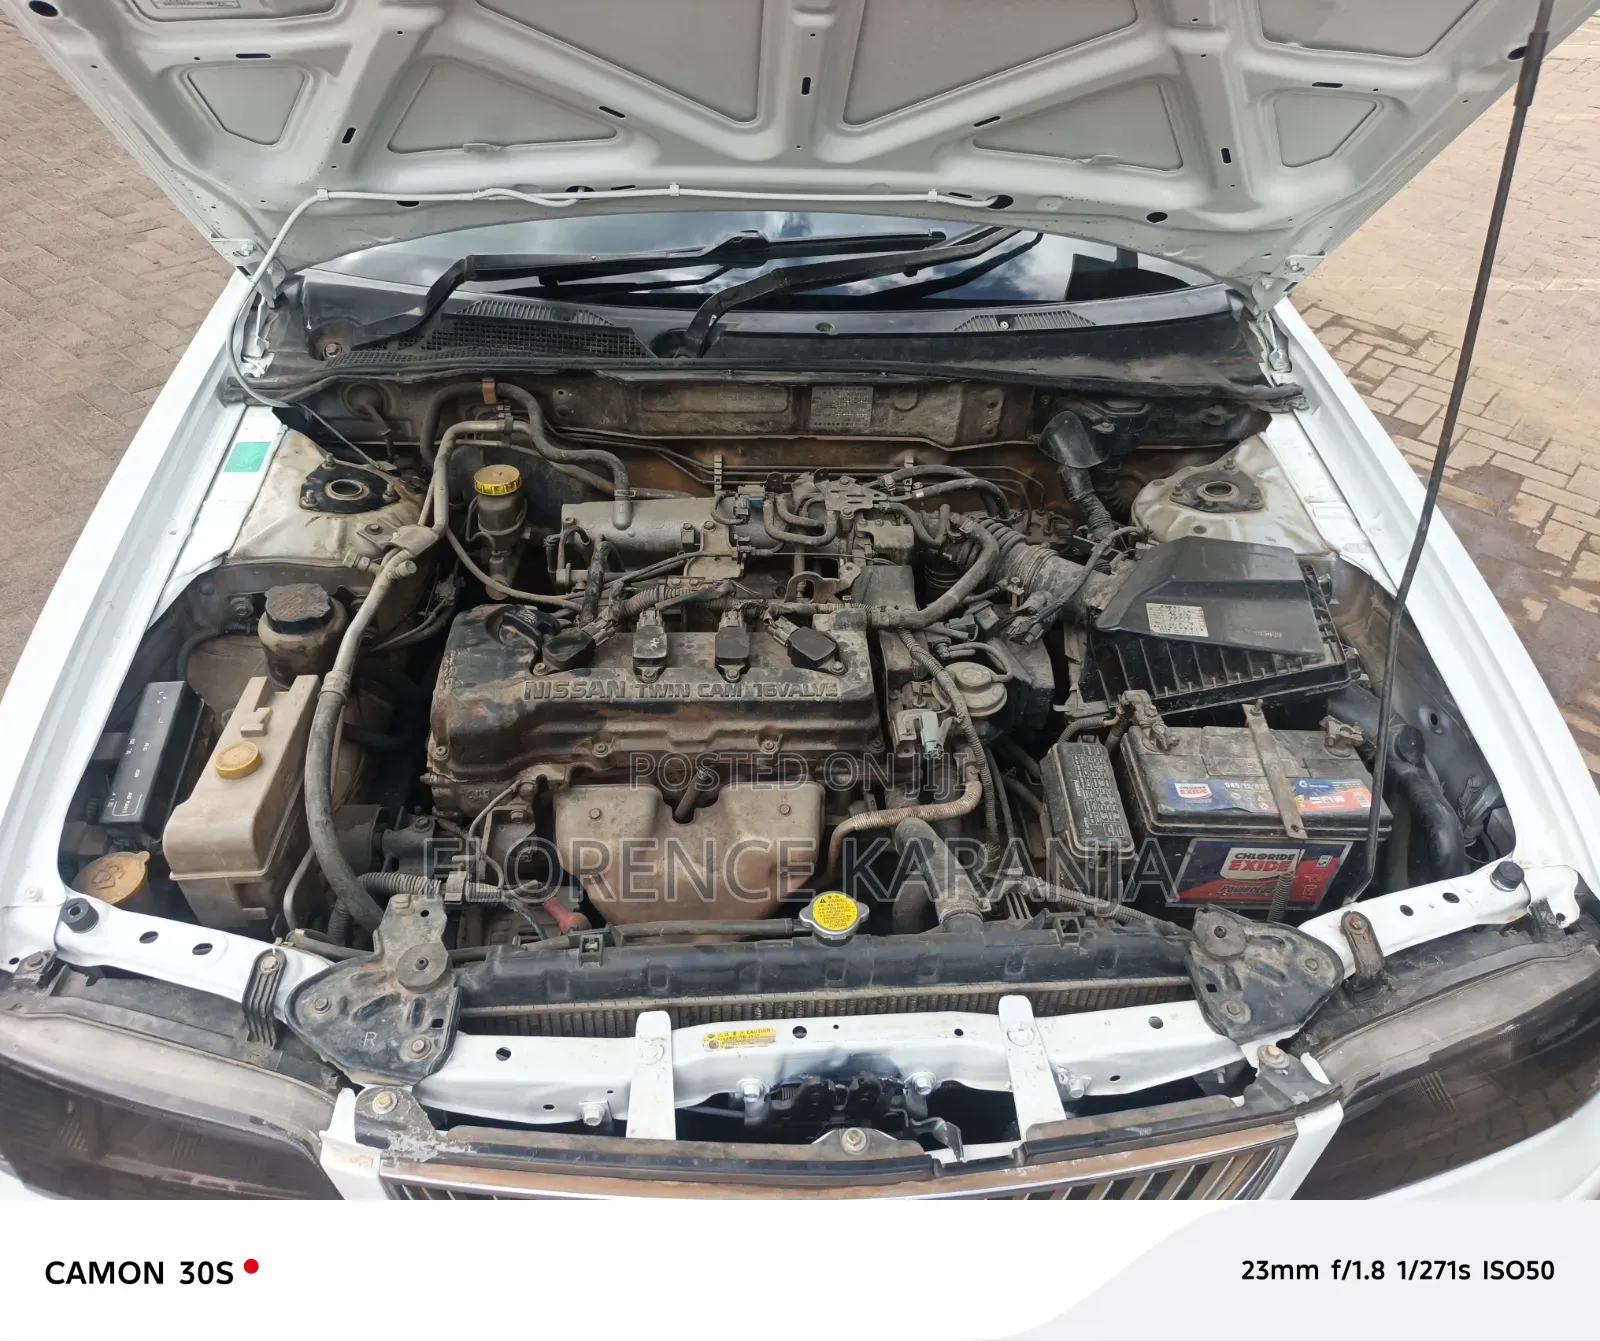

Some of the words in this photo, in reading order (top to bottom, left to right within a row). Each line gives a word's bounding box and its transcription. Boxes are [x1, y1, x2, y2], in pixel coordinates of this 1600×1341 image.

[524, 680, 627, 700] NISSAN
[635, 683, 691, 698] TWIN
[697, 683, 743, 698] CAM
[752, 682, 839, 698] 16VALVE
[1180, 788, 1208, 796] EXIDE
[1234, 852, 1296, 860] CHLORIDE
[1227, 860, 1293, 872] EXIDE
[363, 1031, 377, 1047] R
